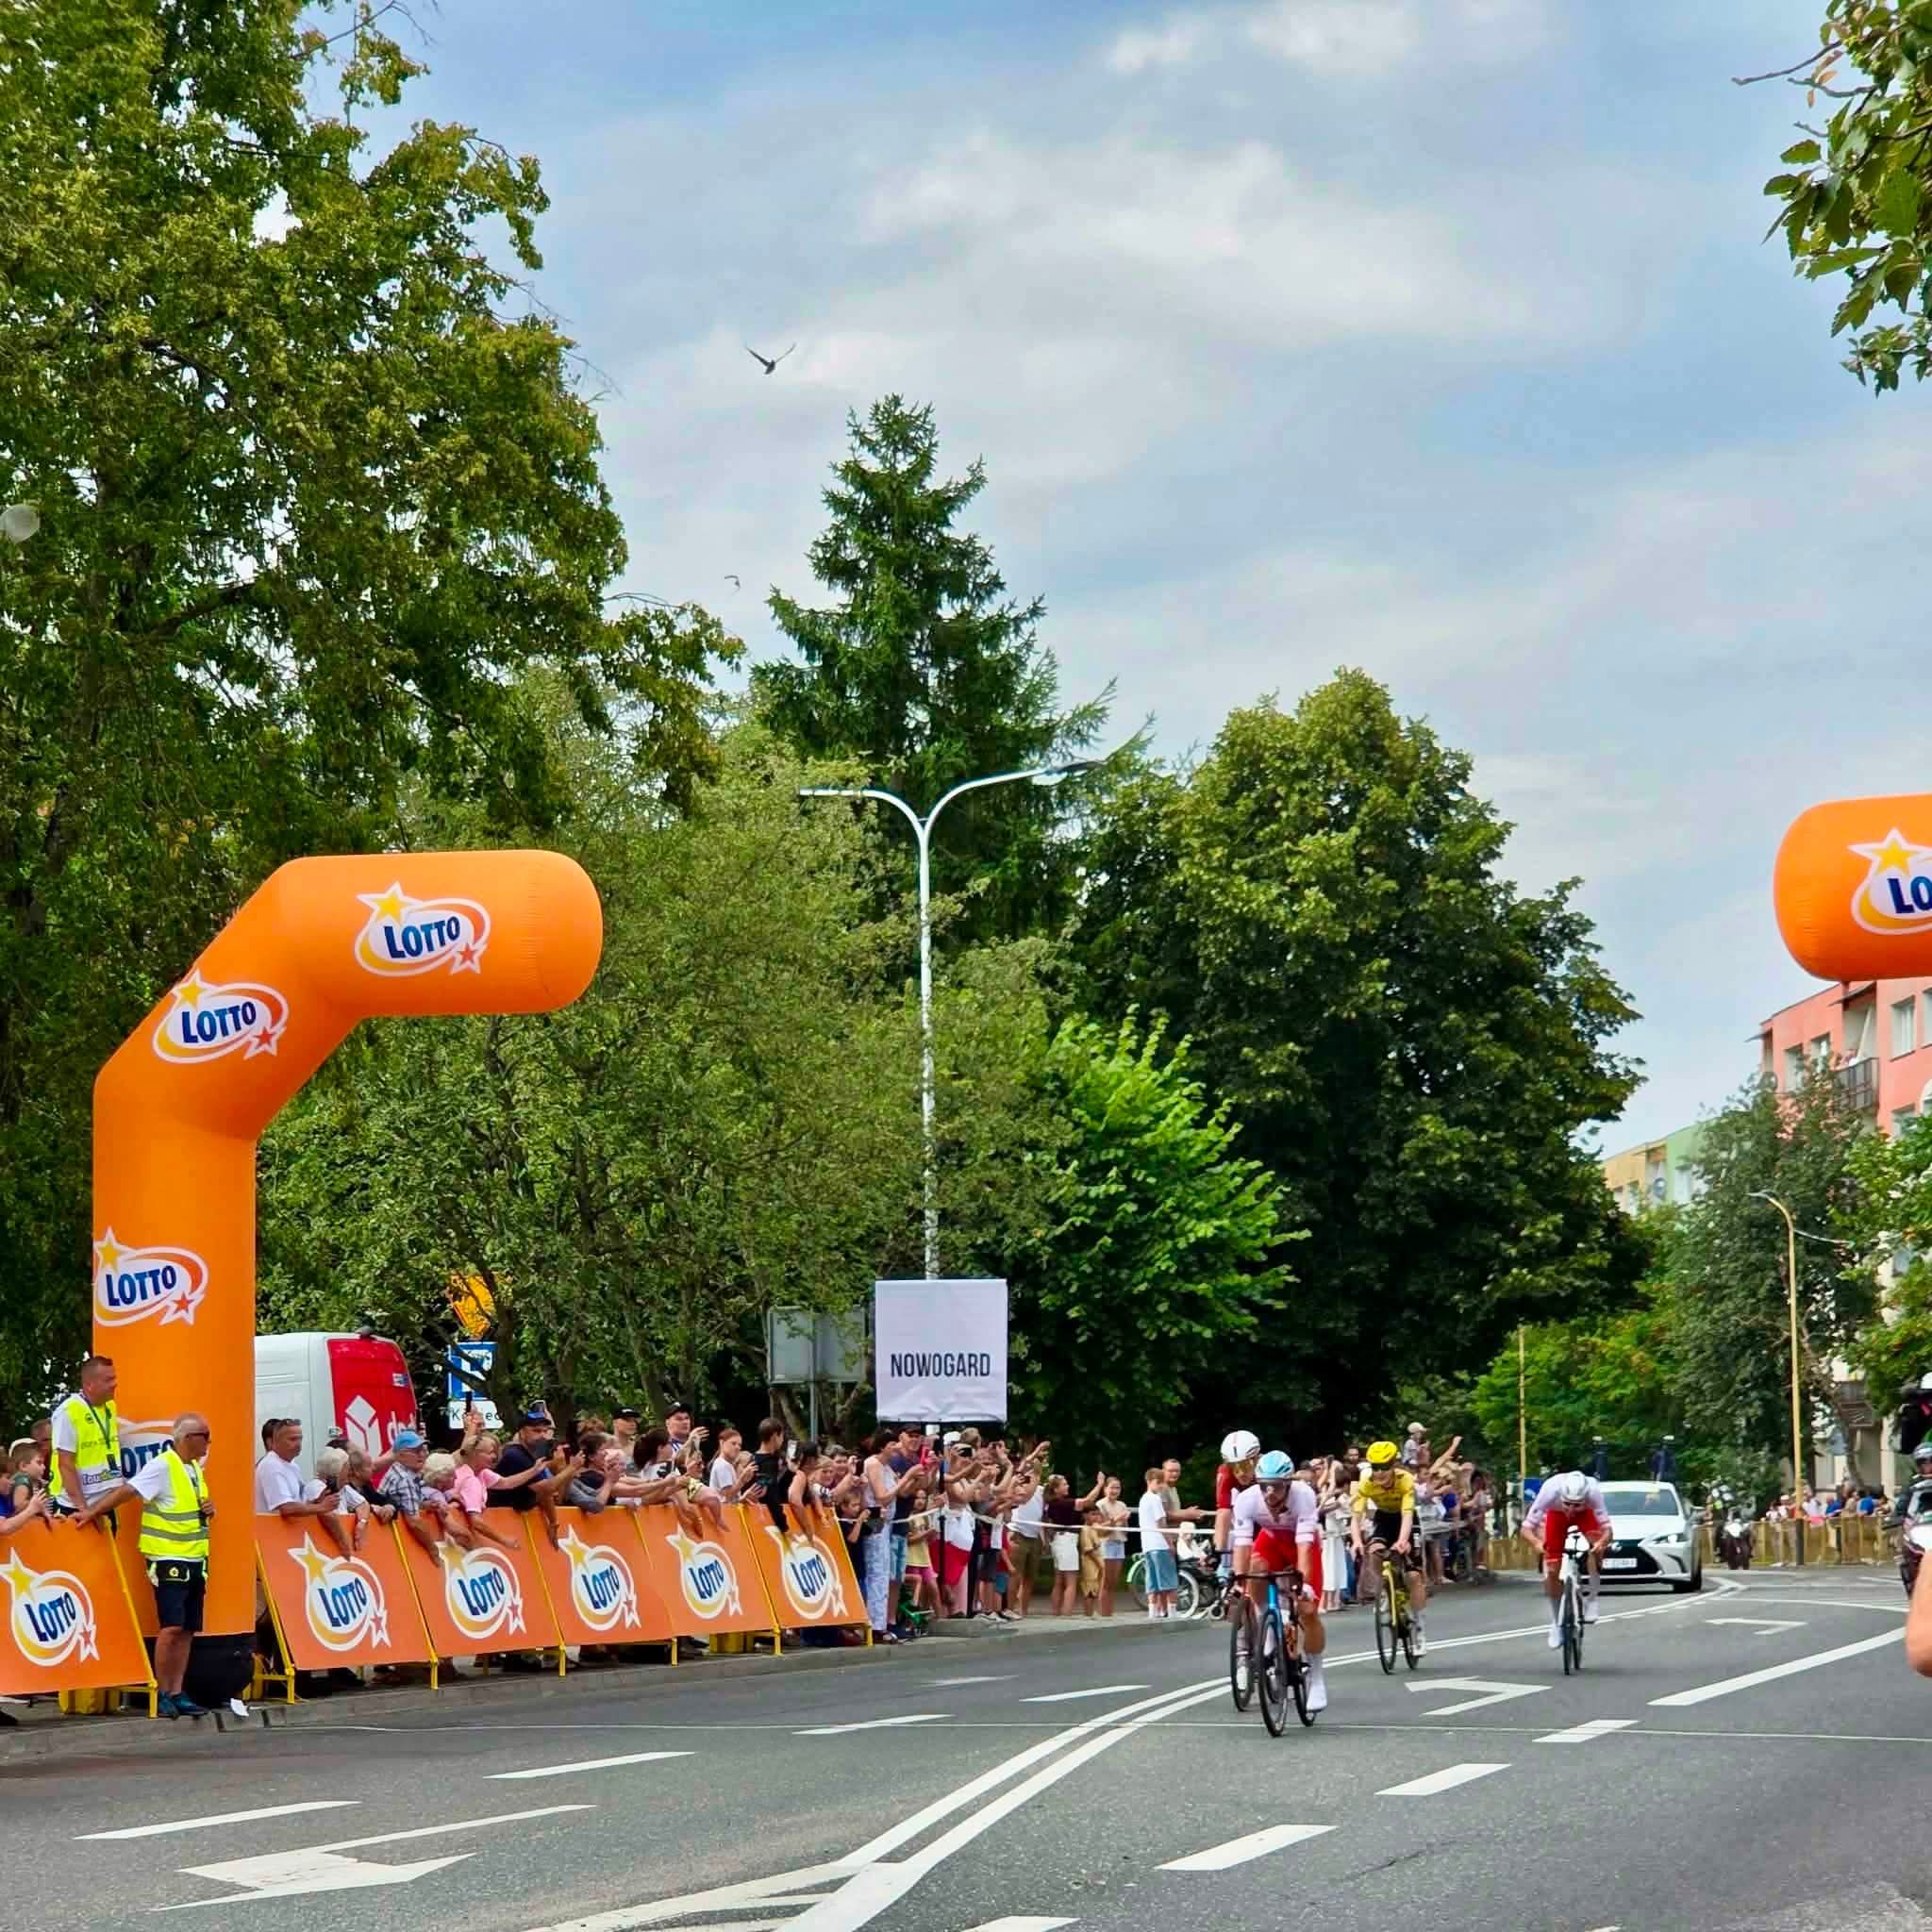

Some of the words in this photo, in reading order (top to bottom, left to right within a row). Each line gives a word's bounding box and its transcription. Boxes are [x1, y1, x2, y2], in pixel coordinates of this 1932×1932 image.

[383, 916, 460, 959] LOTTO
[181, 1001, 257, 1043] LOTTO
[105, 1265, 177, 1307] LOTTO
[891, 1353, 991, 1377] NOWOGARD
[458, 1568, 505, 1616] LOTTO
[581, 1565, 620, 1609] LOTTO
[689, 1559, 724, 1600] LOTTO
[791, 1554, 826, 1598] LOTTO
[24, 1591, 76, 1642] LOTTO
[318, 1577, 367, 1627] LOTTO
